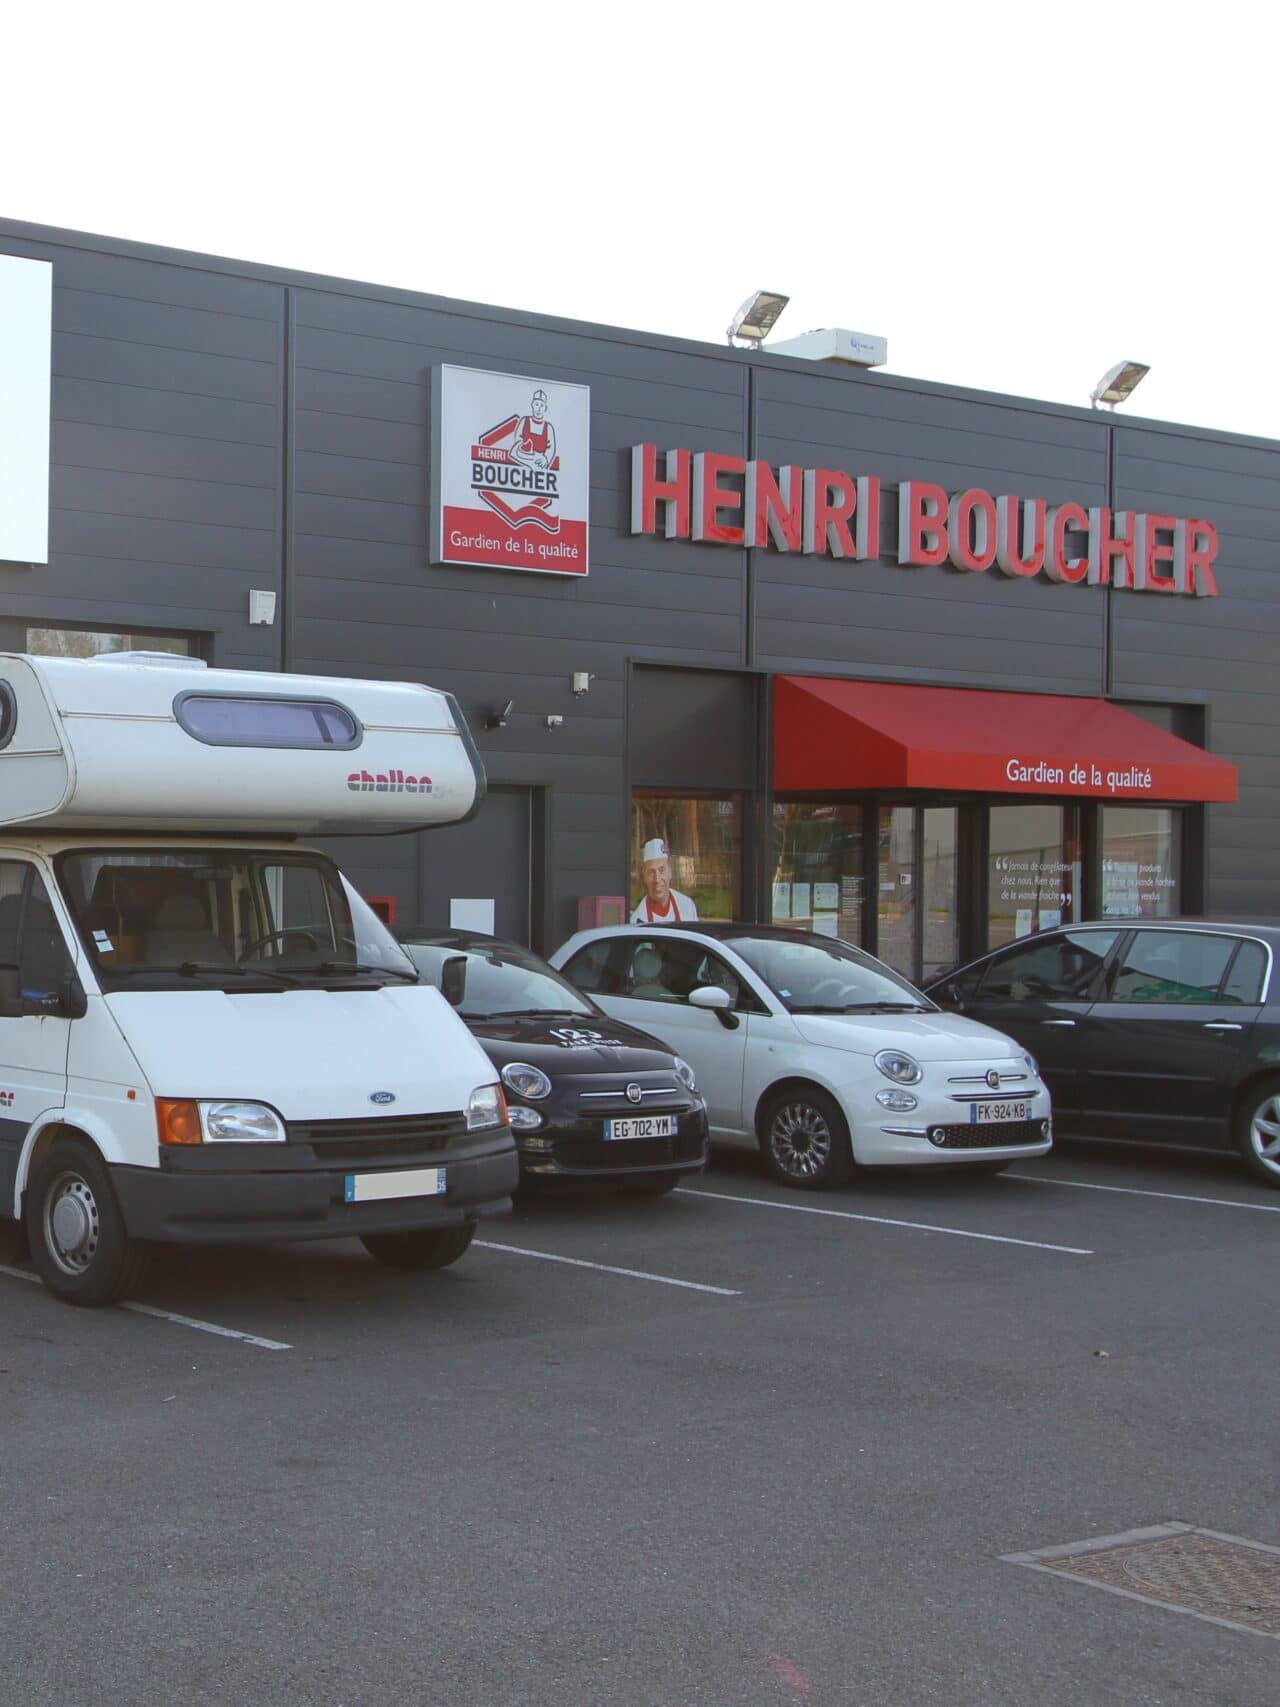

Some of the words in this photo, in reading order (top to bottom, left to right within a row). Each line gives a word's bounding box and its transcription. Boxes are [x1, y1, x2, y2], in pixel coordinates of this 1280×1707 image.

[478, 447, 507, 461] HENRI
[472, 463, 558, 492] BOUCHER
[631, 442, 881, 561] HENRI
[898, 480, 1219, 597] BOUCHER
[450, 530, 501, 551] Gardien
[505, 537, 521, 552] de
[524, 539, 535, 554] la
[538, 543, 579, 560] qualité
[1006, 759, 1064, 784] Gardien
[1069, 763, 1087, 785] de
[1091, 764, 1103, 786] la
[1107, 766, 1152, 793] qualité
